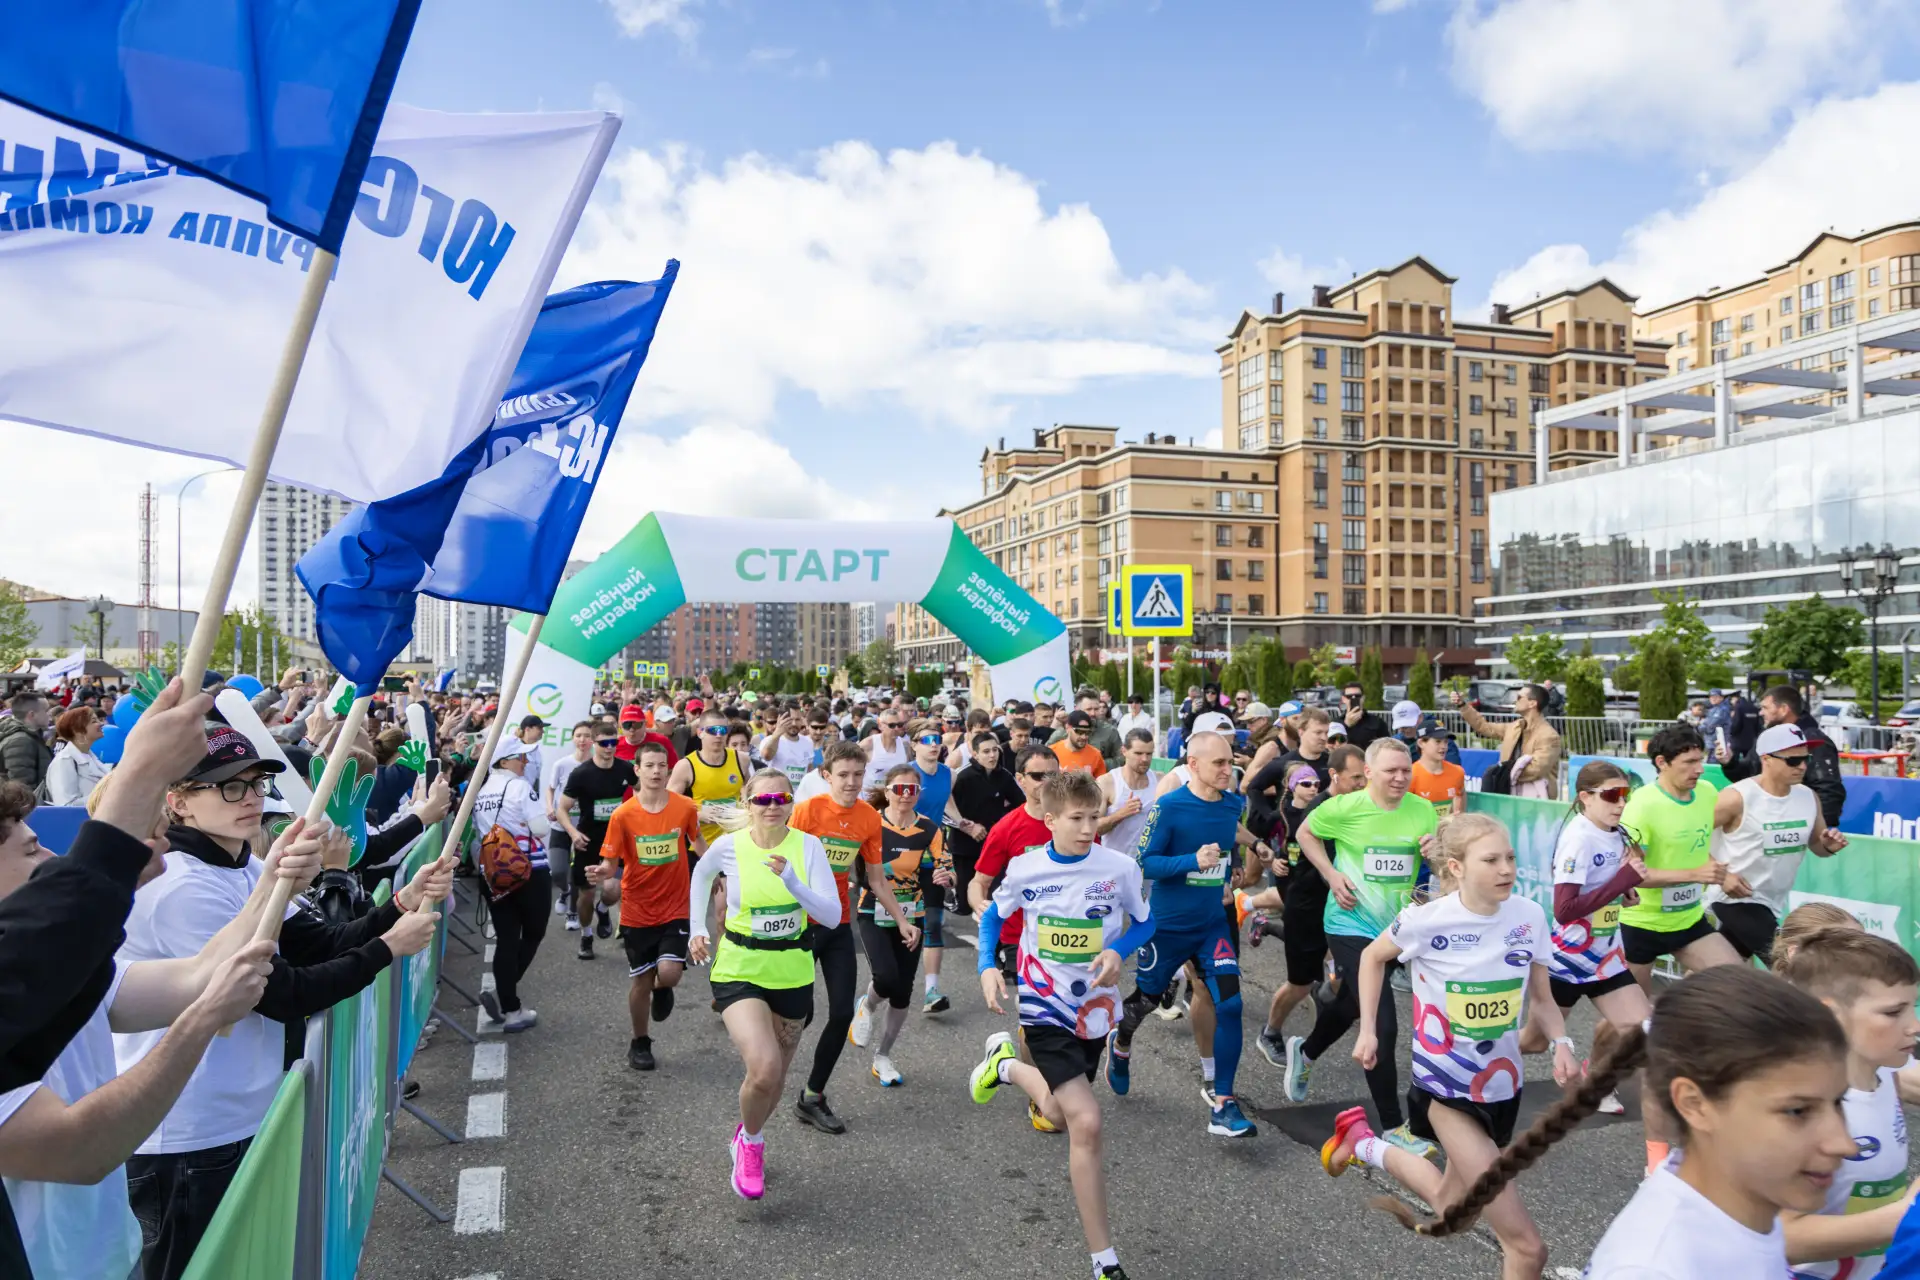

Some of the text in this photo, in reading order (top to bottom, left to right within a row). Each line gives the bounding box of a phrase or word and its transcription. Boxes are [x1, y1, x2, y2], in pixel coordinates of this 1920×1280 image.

[735, 547, 890, 583] СТАРТ
[570, 566, 646, 627] зелёный
[967, 571, 1032, 626] зелёный
[581, 582, 657, 640] марафон
[956, 583, 1021, 637] марафон
[1773, 832, 1801, 844] 0423
[645, 844, 670, 855] 0122
[1375, 859, 1404, 871] 0126
[1036, 885, 1064, 894] СКФУ
[1672, 888, 1697, 902] 0601
[763, 916, 796, 933] 0876
[1051, 932, 1089, 948] 0022
[1450, 933, 1482, 944] СКФУ
[1465, 999, 1510, 1020] 0023
